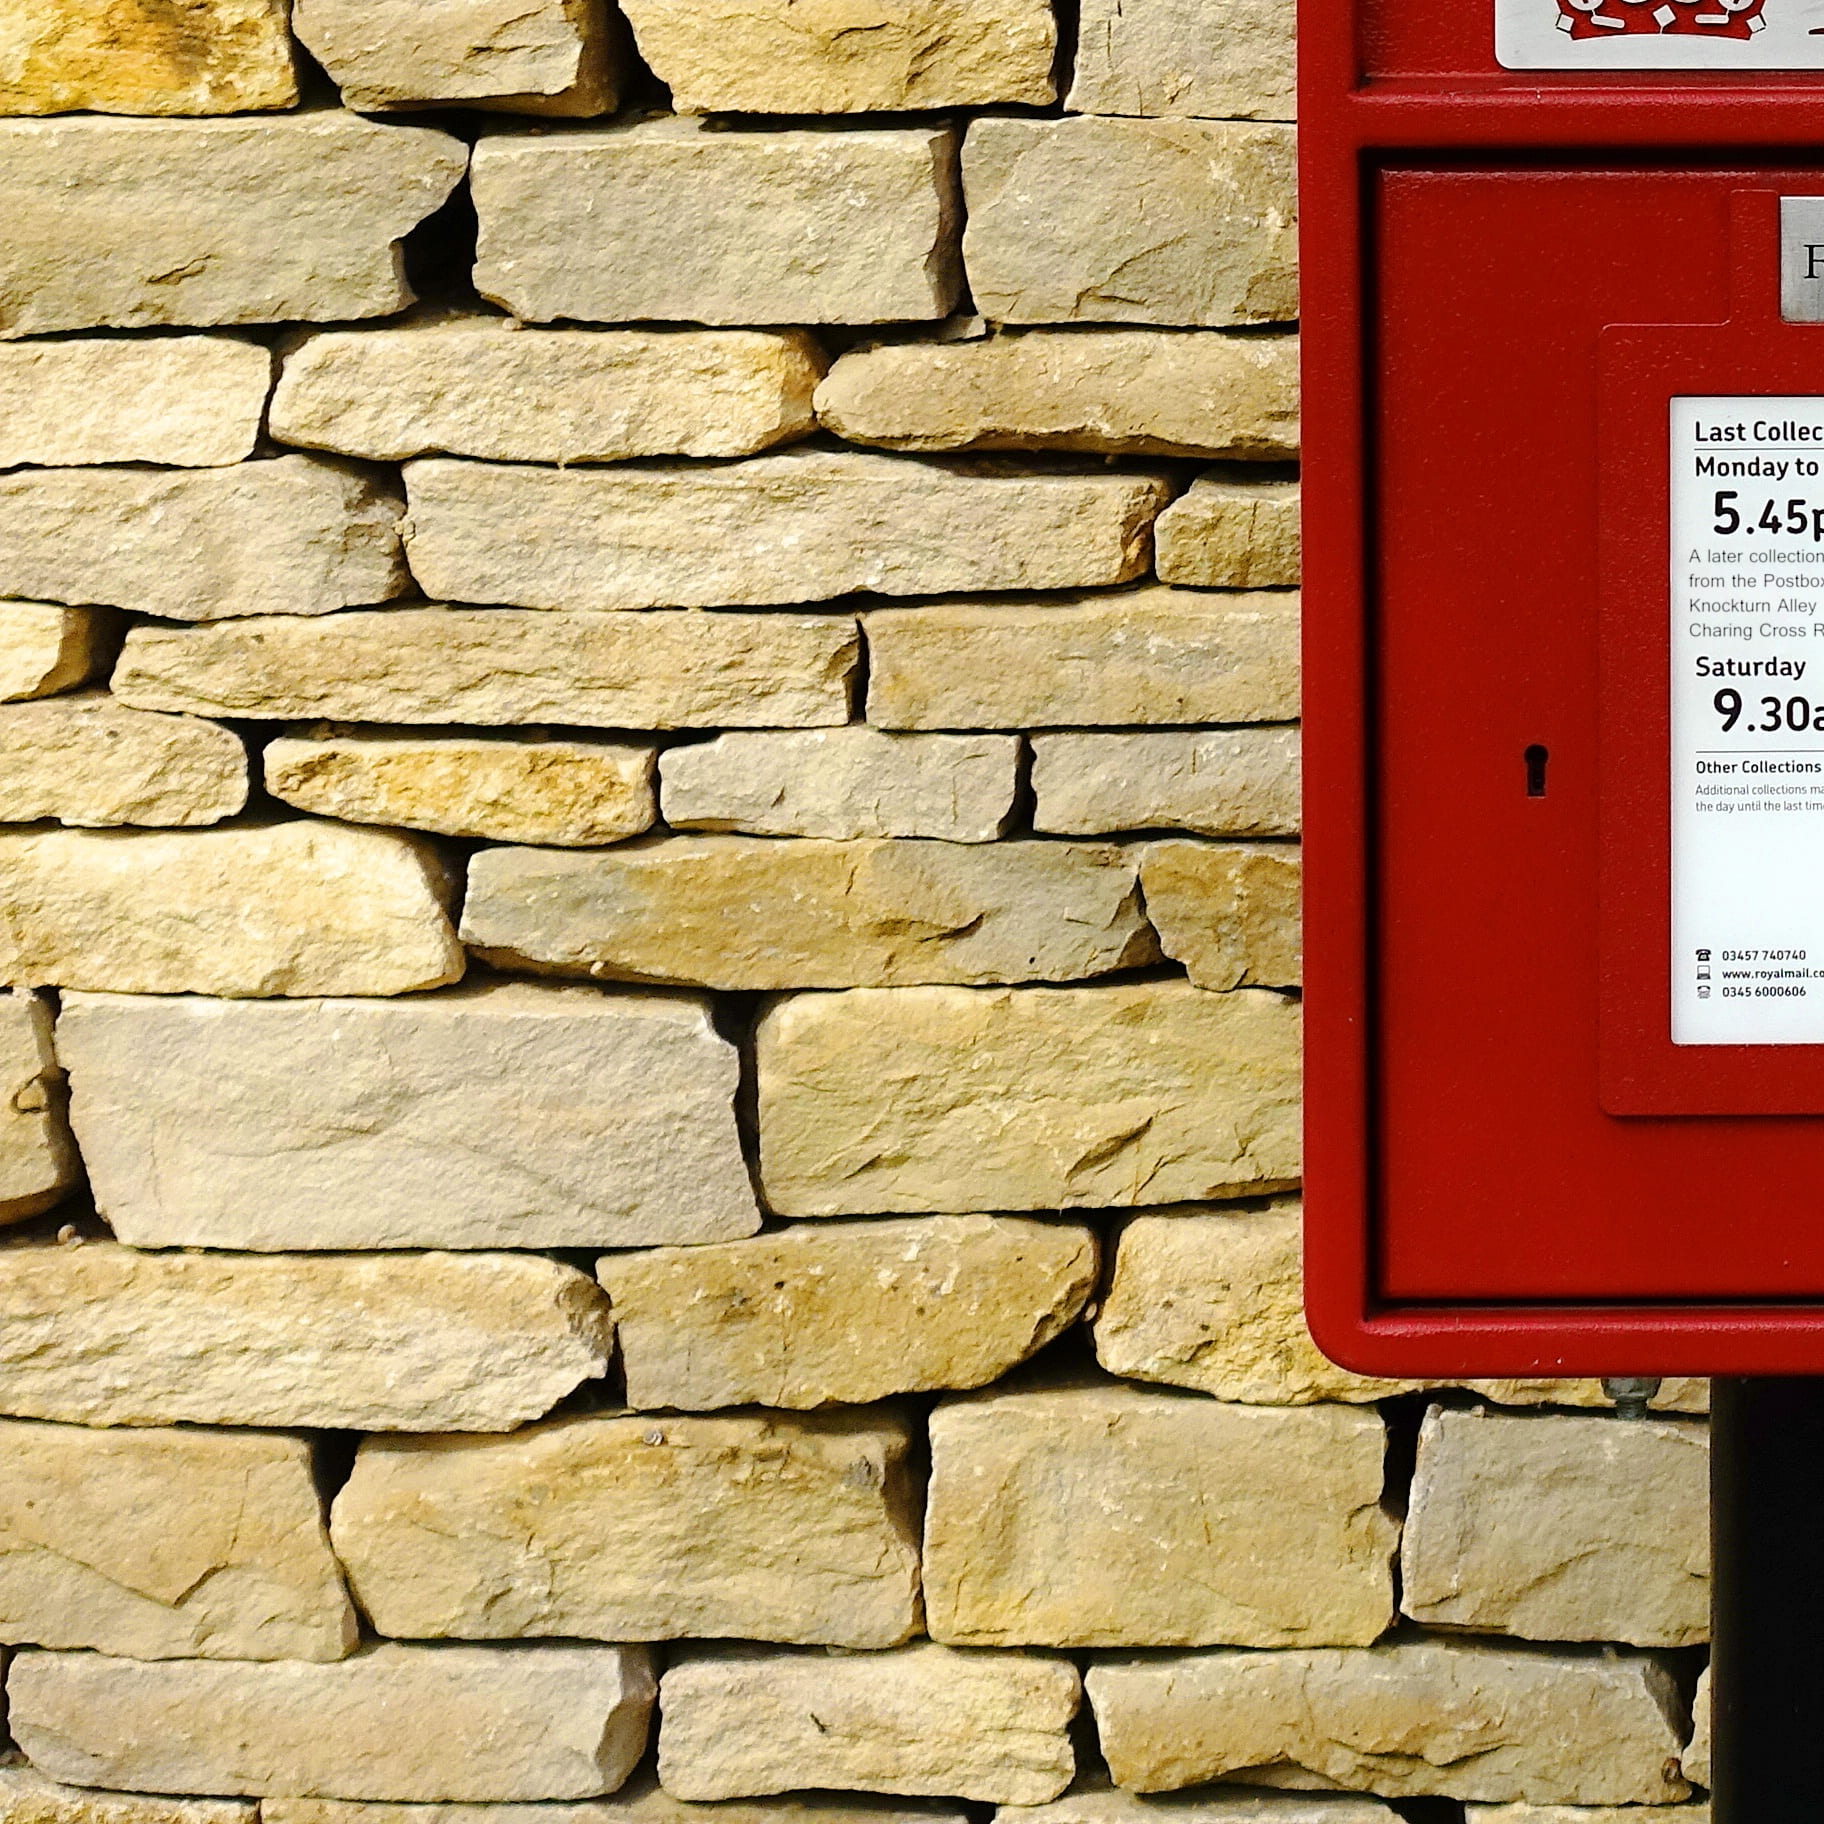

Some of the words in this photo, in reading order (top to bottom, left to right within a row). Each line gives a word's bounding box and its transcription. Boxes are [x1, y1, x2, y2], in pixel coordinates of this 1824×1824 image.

[1696, 421, 1747, 442] Last
[1696, 456, 1789, 481] Monday
[1794, 458, 1819, 476] to
[1689, 549, 1701, 563] A
[1708, 549, 1743, 563] later
[1749, 549, 1824, 563] collection
[1689, 573, 1724, 587] from
[1732, 574, 1756, 587] the
[1690, 599, 1770, 612] Knockturn
[1777, 598, 1816, 616] Alley
[1689, 623, 1752, 640] Charing
[1760, 623, 1806, 637] Cross
[1696, 656, 1806, 681] Saturday
[1696, 761, 1738, 774] Other
[1742, 760, 1822, 773] Collections
[1695, 784, 1749, 795] Additional
[1752, 784, 1807, 795] collections
[1696, 801, 1713, 812] the
[1716, 801, 1735, 814] day
[1737, 800, 1761, 811] until
[1764, 800, 1781, 811] the
[1784, 801, 1802, 811] last
[1722, 950, 1758, 960] 03457
[1762, 950, 1806, 960] 740740
[1722, 987, 1751, 997] 0345
[1755, 986, 1806, 997] 6000606
